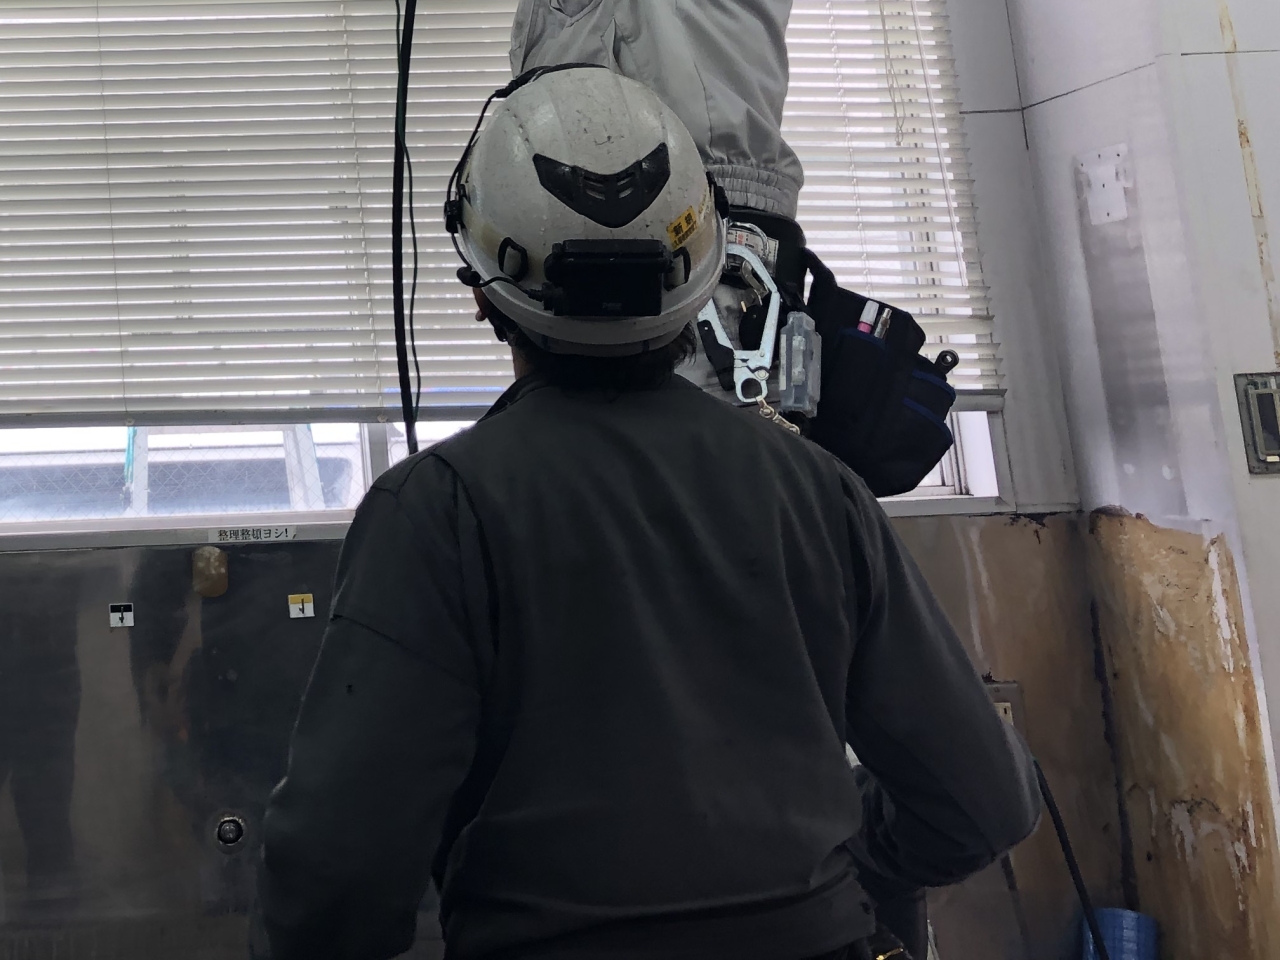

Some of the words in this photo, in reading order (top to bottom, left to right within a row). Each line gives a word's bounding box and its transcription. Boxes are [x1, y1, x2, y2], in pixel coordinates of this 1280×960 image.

[217, 528, 289, 542] 整理整頓ヨシ!
